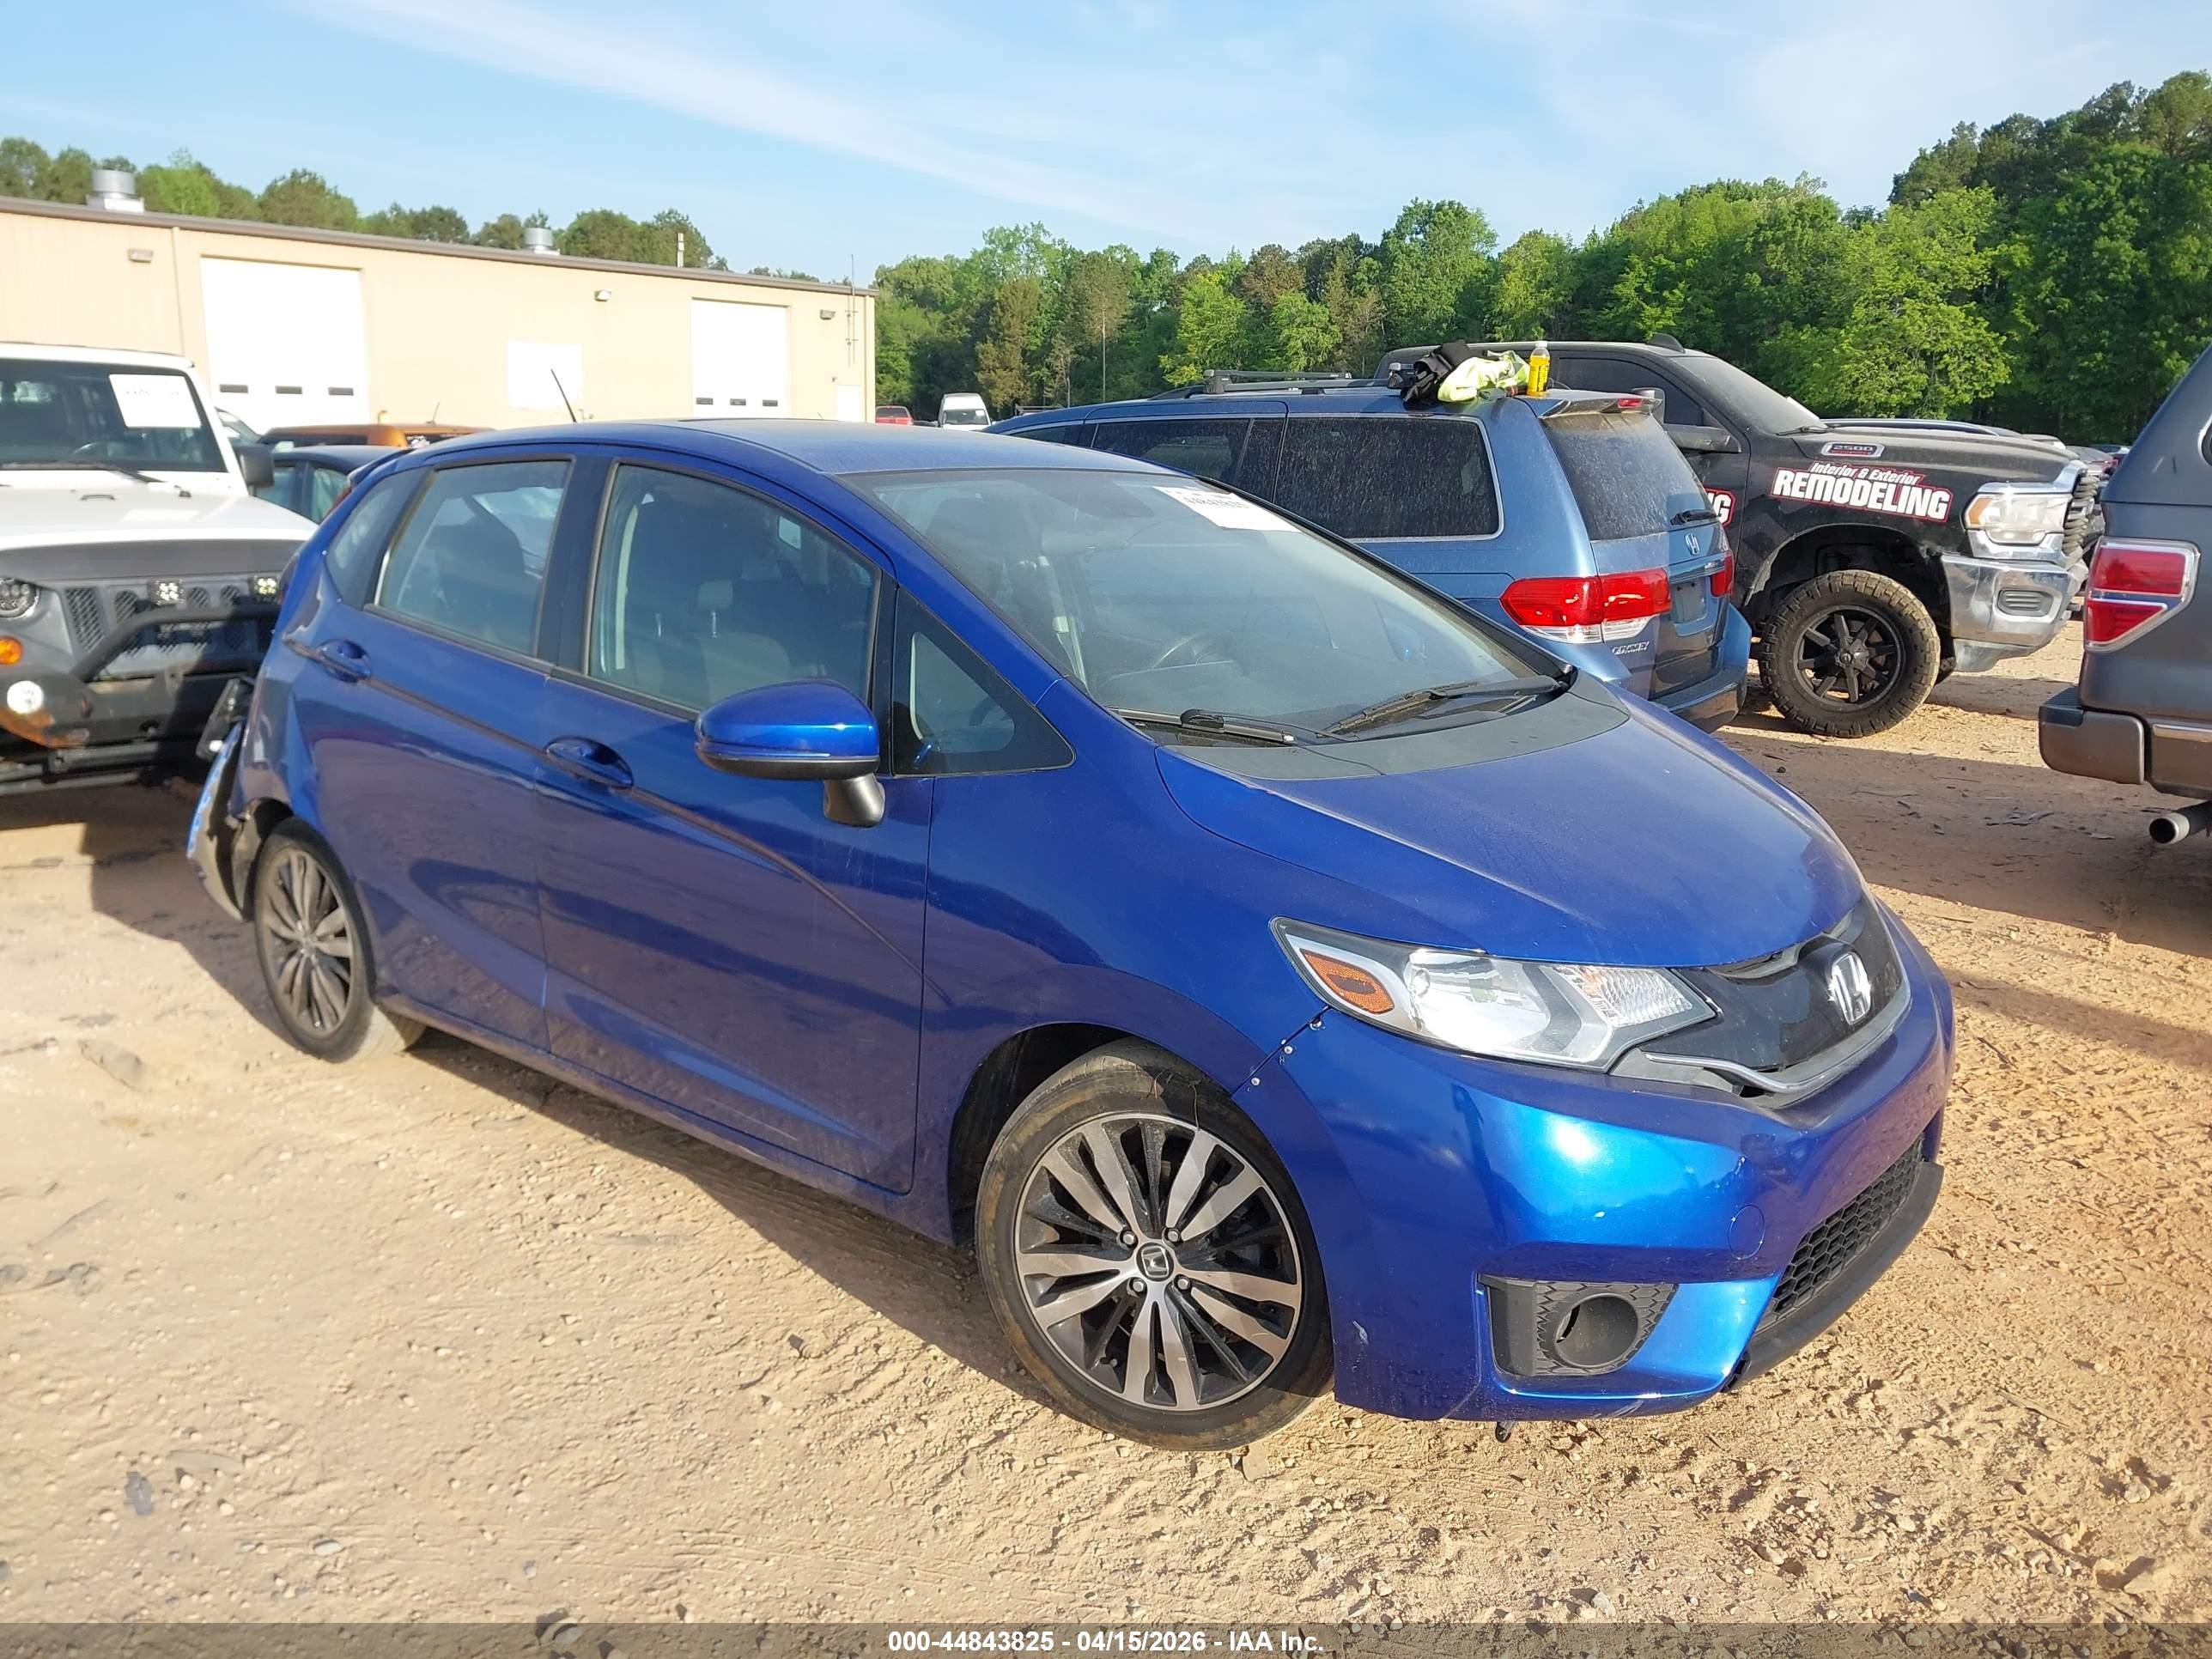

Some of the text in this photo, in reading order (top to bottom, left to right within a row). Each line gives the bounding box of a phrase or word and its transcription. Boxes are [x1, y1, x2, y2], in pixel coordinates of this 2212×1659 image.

[1810, 462, 1921, 485] Interior & Exterior
[1772, 469, 1950, 520] REMODELING
